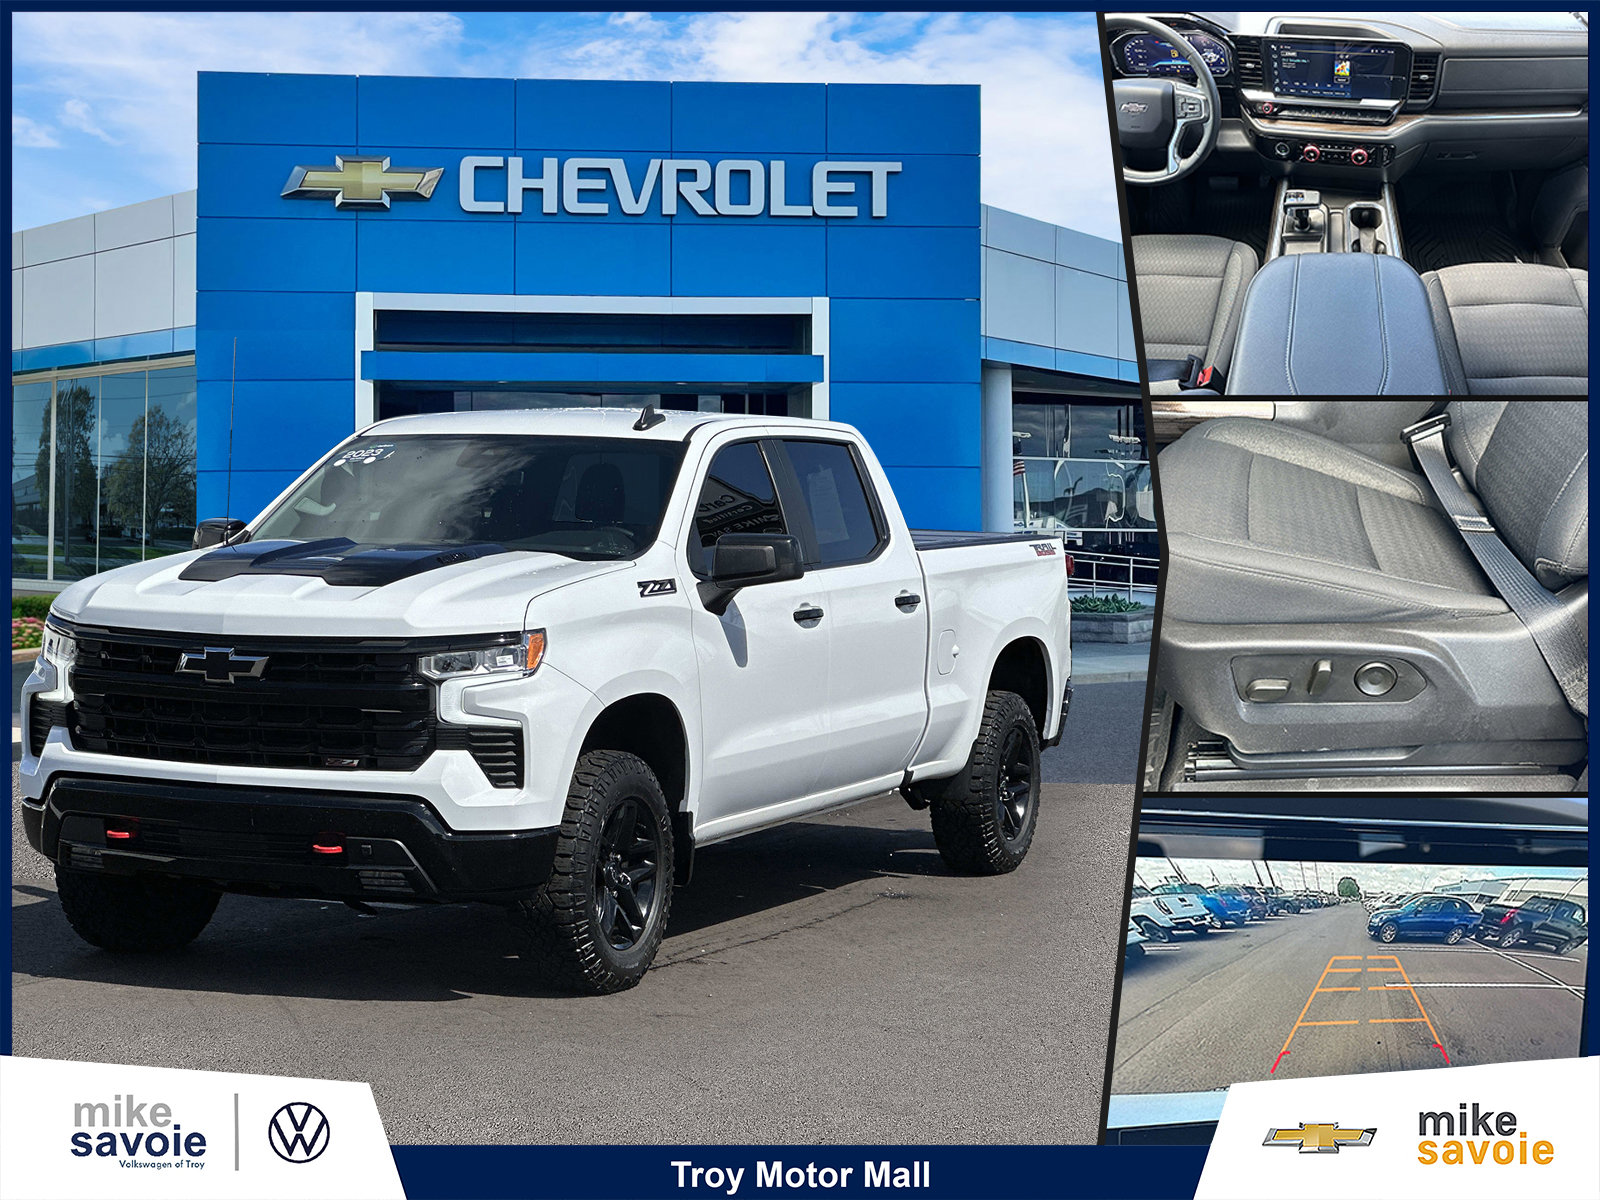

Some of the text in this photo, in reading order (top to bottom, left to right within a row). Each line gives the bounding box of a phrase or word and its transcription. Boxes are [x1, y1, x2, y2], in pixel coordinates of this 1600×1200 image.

[459, 155, 902, 217] CHEVROLET
[343, 448, 384, 459] 2023
[1029, 543, 1057, 551] TRAIL
[637, 578, 677, 598] Z71
